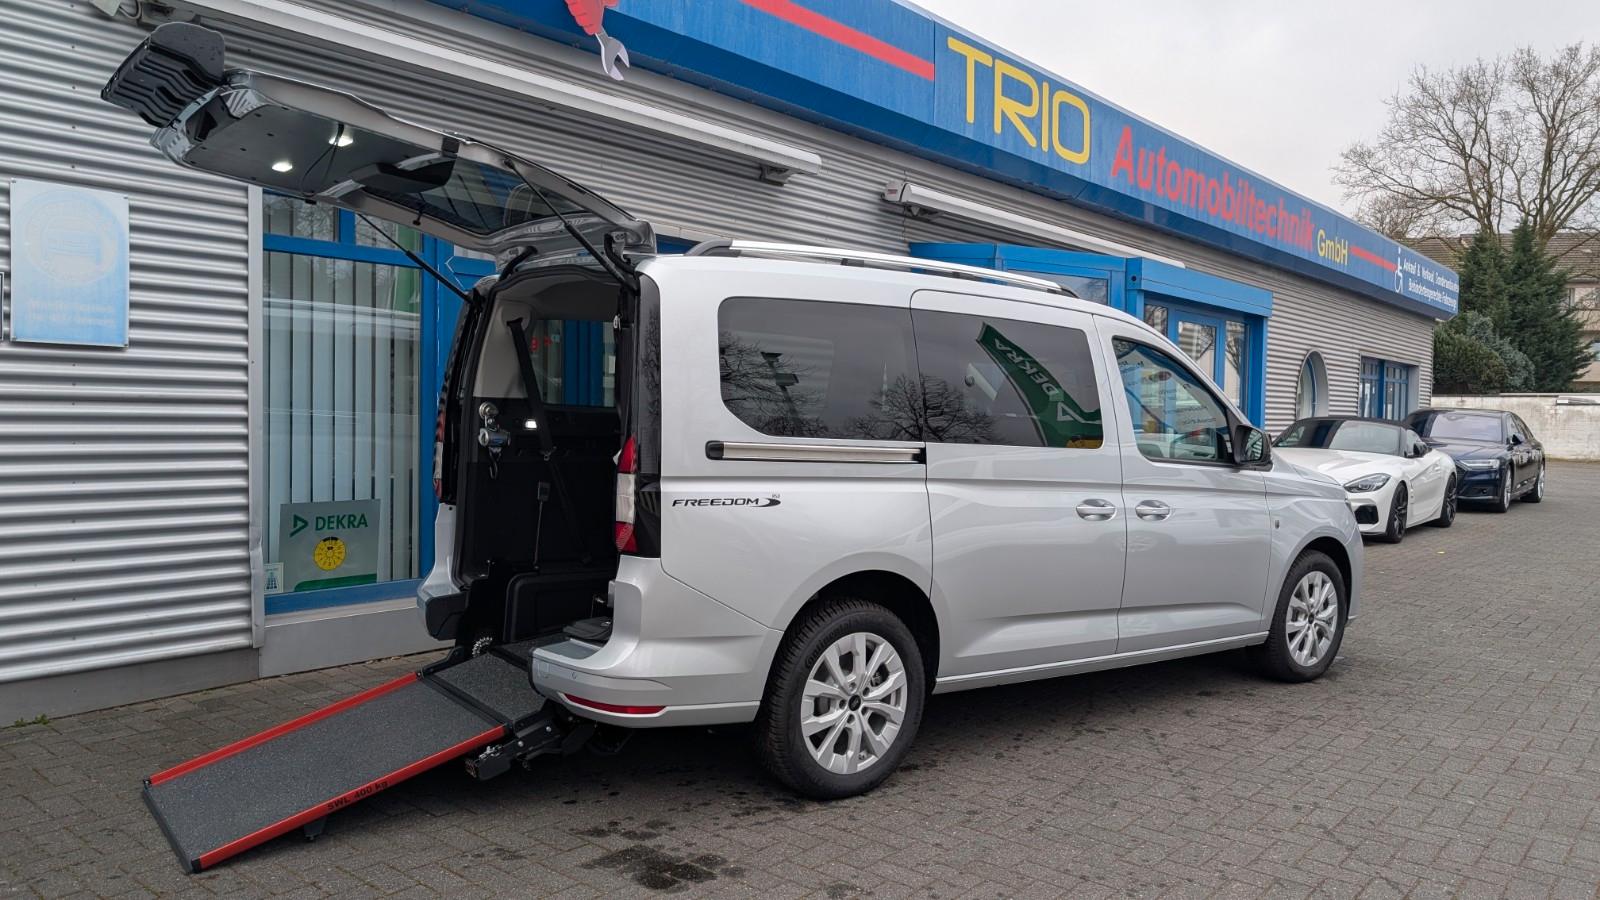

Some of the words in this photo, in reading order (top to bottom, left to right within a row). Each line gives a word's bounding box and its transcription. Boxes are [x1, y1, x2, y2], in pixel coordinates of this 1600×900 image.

[947, 36, 1091, 165] TRIO
[1111, 124, 1315, 251] Automobiltechnik
[1317, 229, 1349, 265] GmbH
[994, 338, 1061, 395] DEKRA
[672, 498, 759, 507] FREEDOM
[315, 513, 368, 531] DEKRA
[327, 797, 351, 810] SWL
[354, 786, 373, 798] 400
[374, 781, 389, 792] kg
